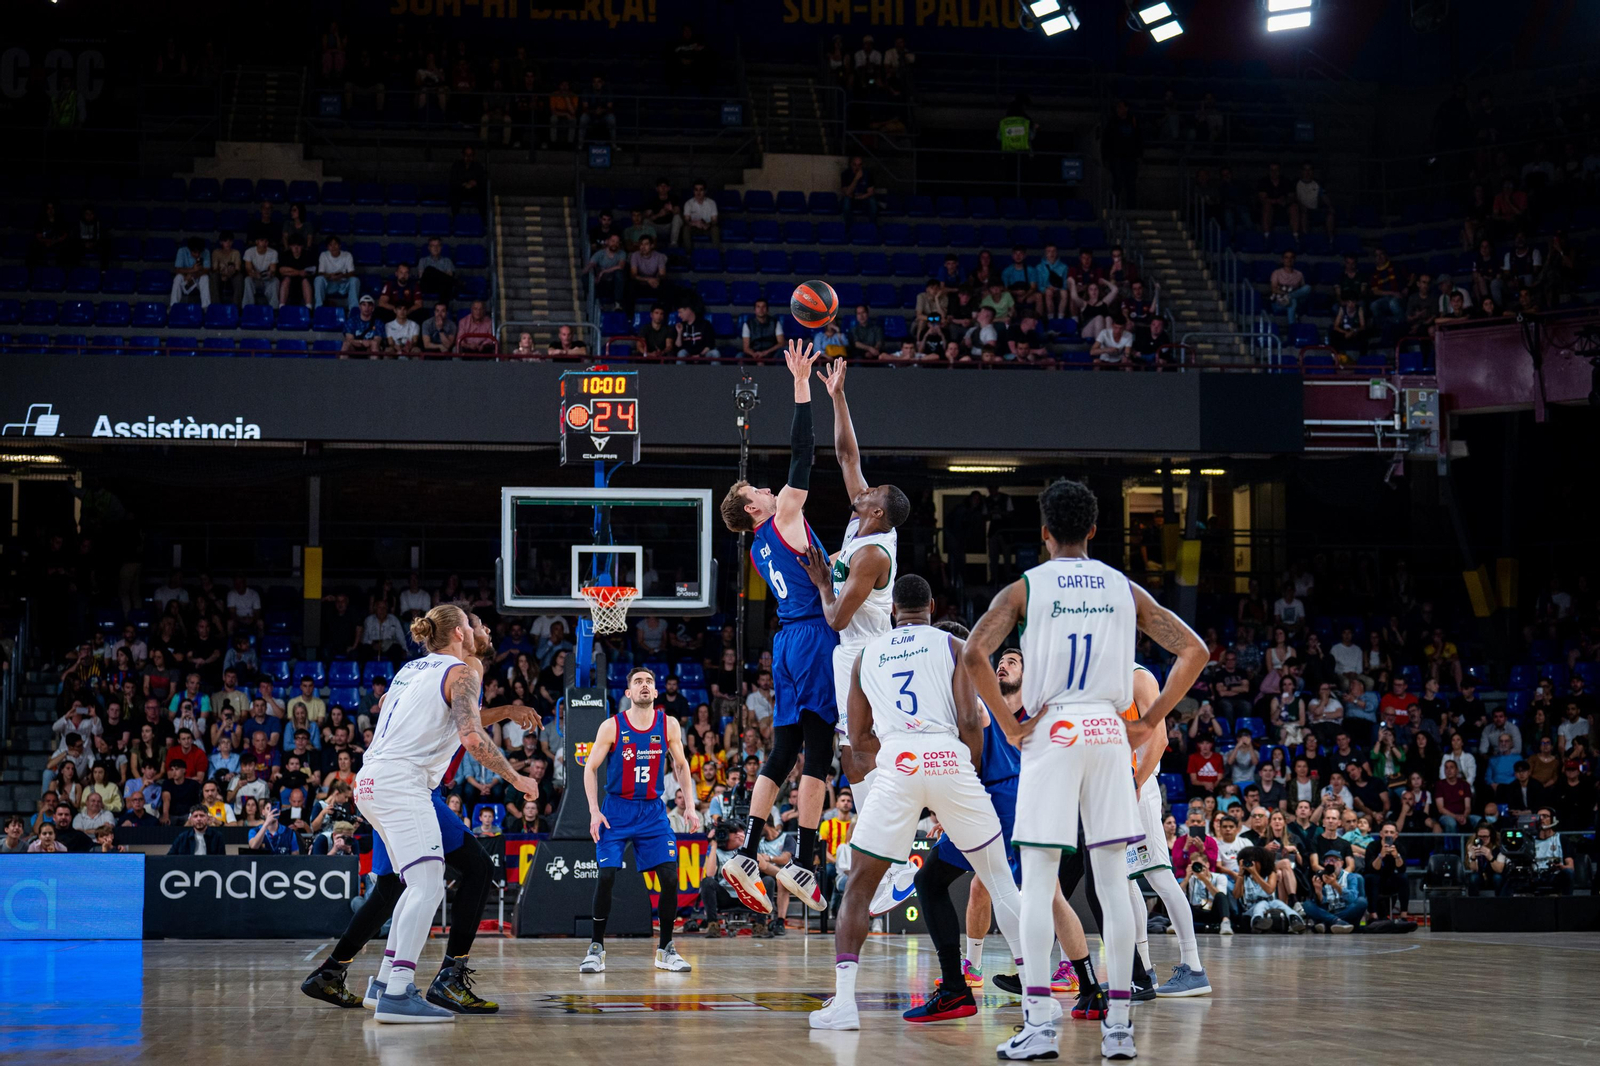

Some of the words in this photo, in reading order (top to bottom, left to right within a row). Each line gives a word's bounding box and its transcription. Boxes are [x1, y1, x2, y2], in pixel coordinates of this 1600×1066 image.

[583, 377, 626, 394] 10:00
[594, 402, 635, 432] 24
[92, 414, 261, 439] Assistència
[768, 560, 788, 600] 6
[1057, 575, 1106, 589] CARTER
[891, 635, 916, 646] EJIM
[1067, 633, 1093, 691] 11
[892, 670, 918, 716] 3
[571, 699, 604, 708] SPALDING
[1082, 718, 1120, 728] COSTA
[1083, 729, 1104, 737] DEL
[923, 750, 958, 760] COSTA
[923, 761, 941, 769] DEL
[942, 760, 960, 768] SOL
[634, 766, 651, 783] 13
[912, 841, 930, 850] CAL
[160, 861, 351, 900] endesa
[906, 906, 919, 922] 0
